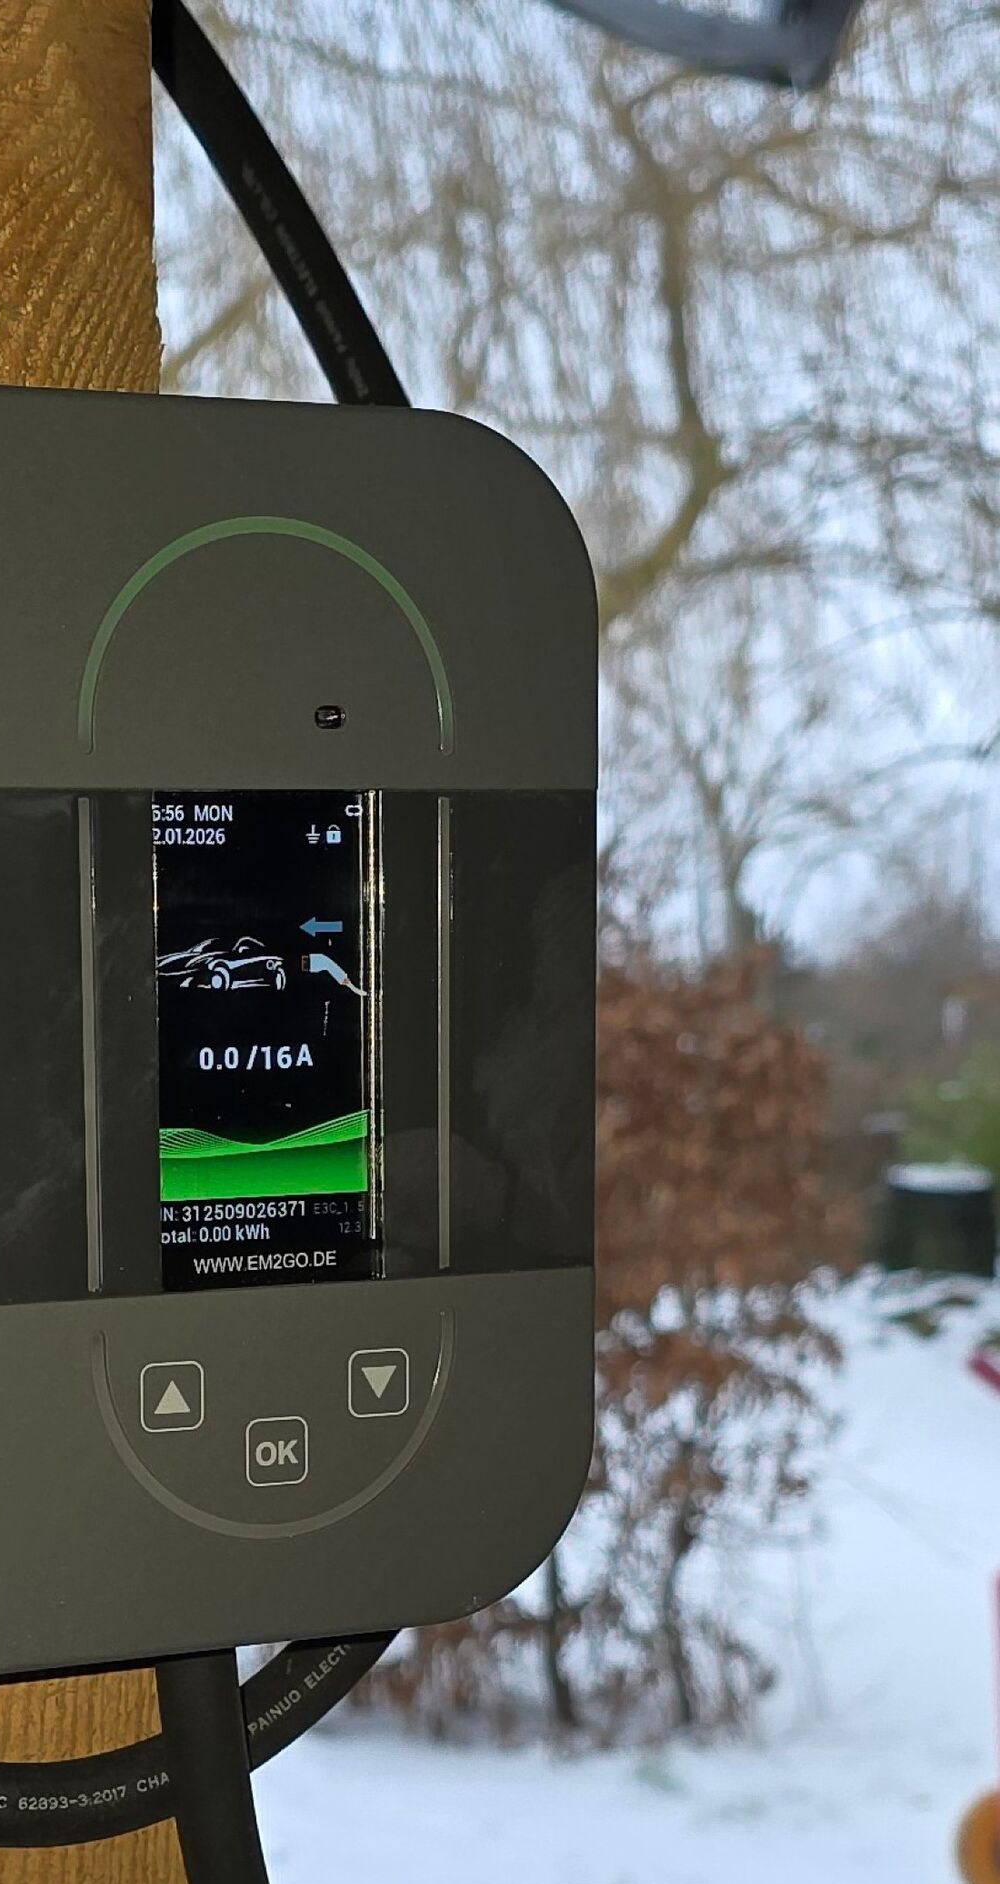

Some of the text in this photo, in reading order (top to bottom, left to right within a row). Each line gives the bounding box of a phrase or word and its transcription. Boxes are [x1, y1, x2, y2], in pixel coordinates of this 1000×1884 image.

[194, 804, 233, 822] MON
[200, 1225, 232, 1243] 0.00
[235, 1222, 270, 1242] kWh
[193, 1250, 337, 1275] WWW.EM2GO.DE
[255, 1439, 299, 1467] OK
[247, 1644, 351, 1737] PAINUO ELECT
[136, 1771, 171, 1793] CHA
